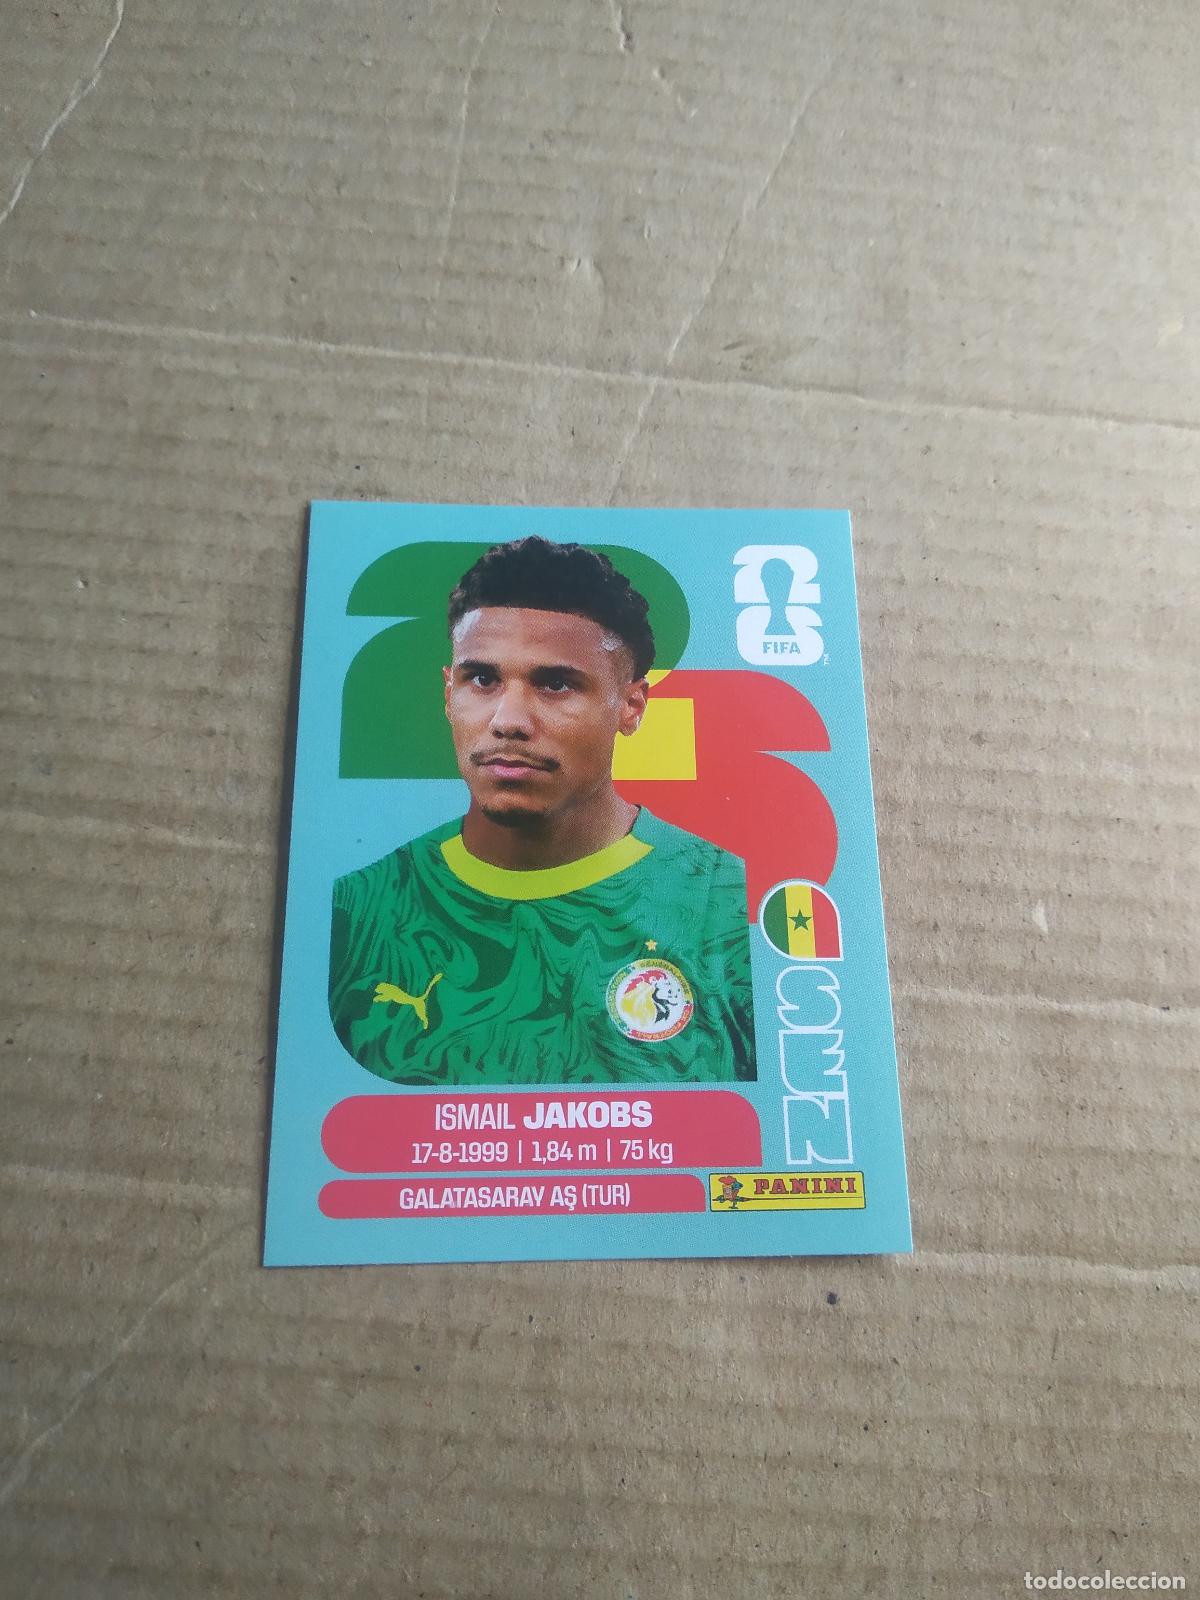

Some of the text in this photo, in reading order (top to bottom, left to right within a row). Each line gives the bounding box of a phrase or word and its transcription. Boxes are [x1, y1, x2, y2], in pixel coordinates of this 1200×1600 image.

[762, 641, 801, 654] FIFA
[435, 1100, 653, 1131] ISMAIL JAKOBS
[411, 1141, 509, 1164] 17-8-1999
[531, 1140, 574, 1165] 1,84
[578, 1143, 597, 1161] m
[620, 1139, 644, 1161] 75
[648, 1138, 673, 1164] kg
[399, 1182, 631, 1211] GALATASARAY AŞ (TUR)
[754, 1177, 857, 1195] PANINI
